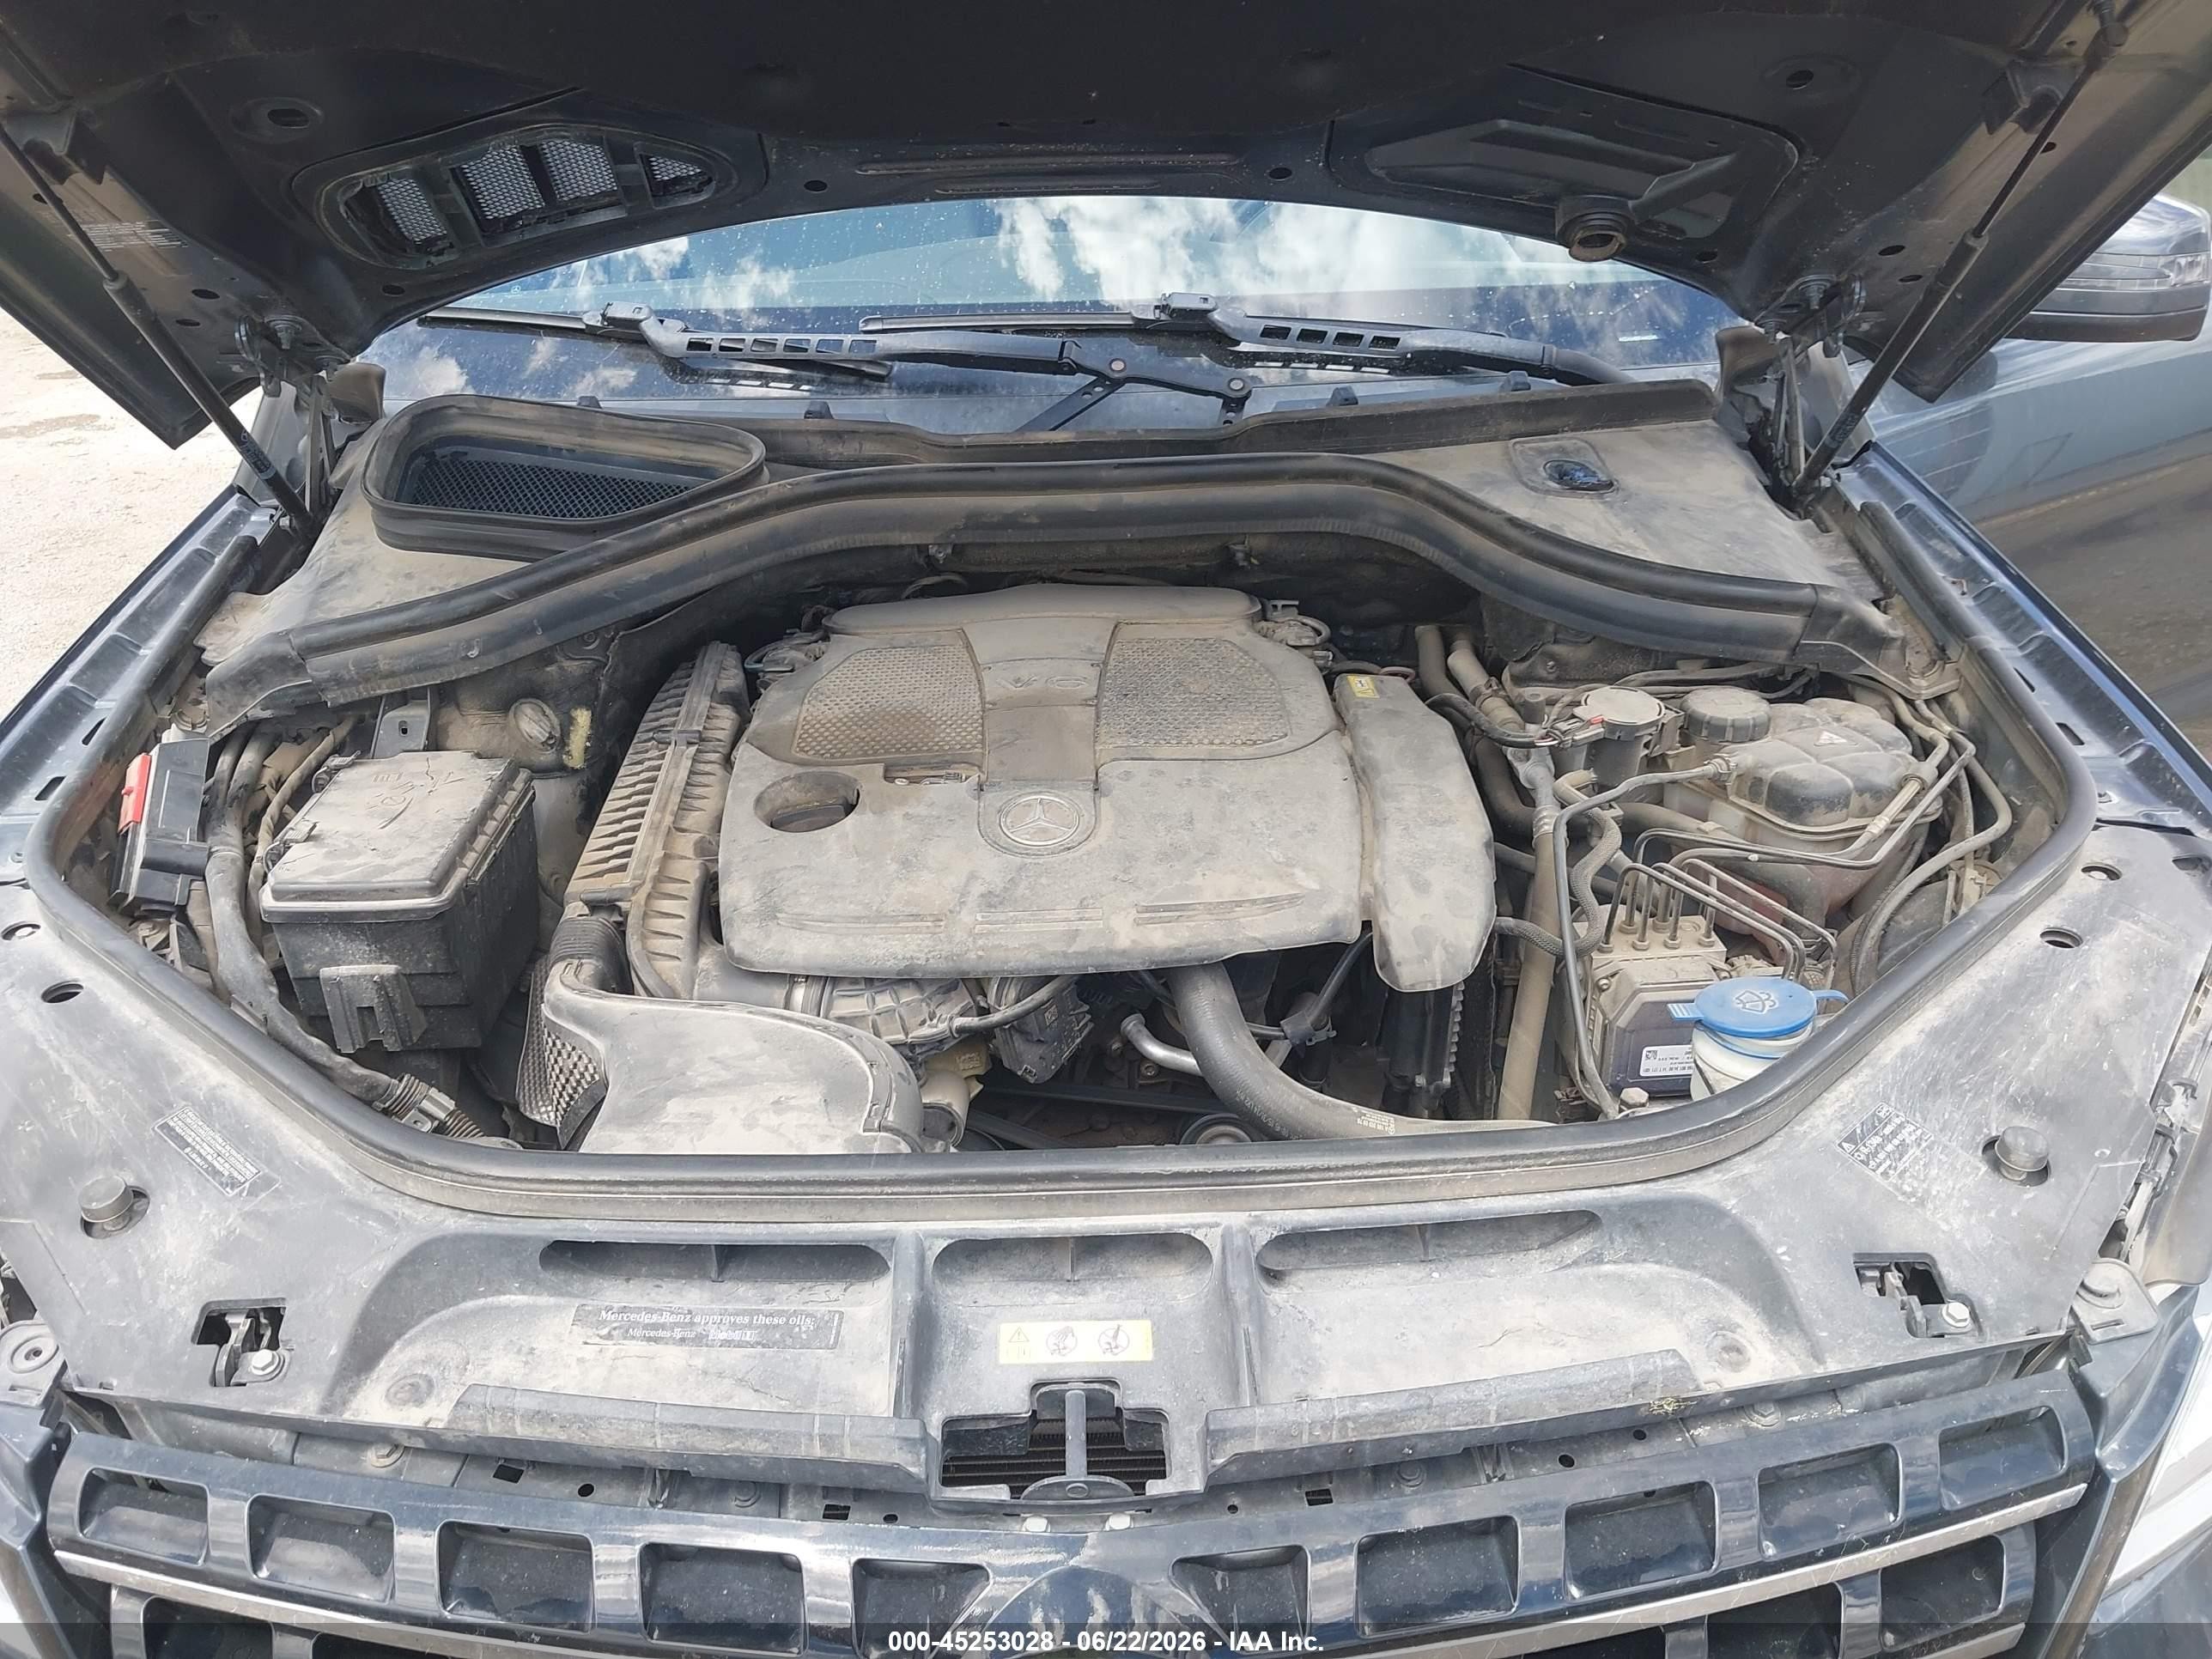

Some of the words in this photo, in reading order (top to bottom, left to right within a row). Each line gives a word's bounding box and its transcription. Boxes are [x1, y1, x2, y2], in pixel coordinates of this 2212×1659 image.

[599, 1310, 692, 1323] Mercedes-Benz
[693, 1314, 750, 1326] approves
[752, 1313, 787, 1325] these
[628, 1327, 697, 1339] Mercedes-Benz
